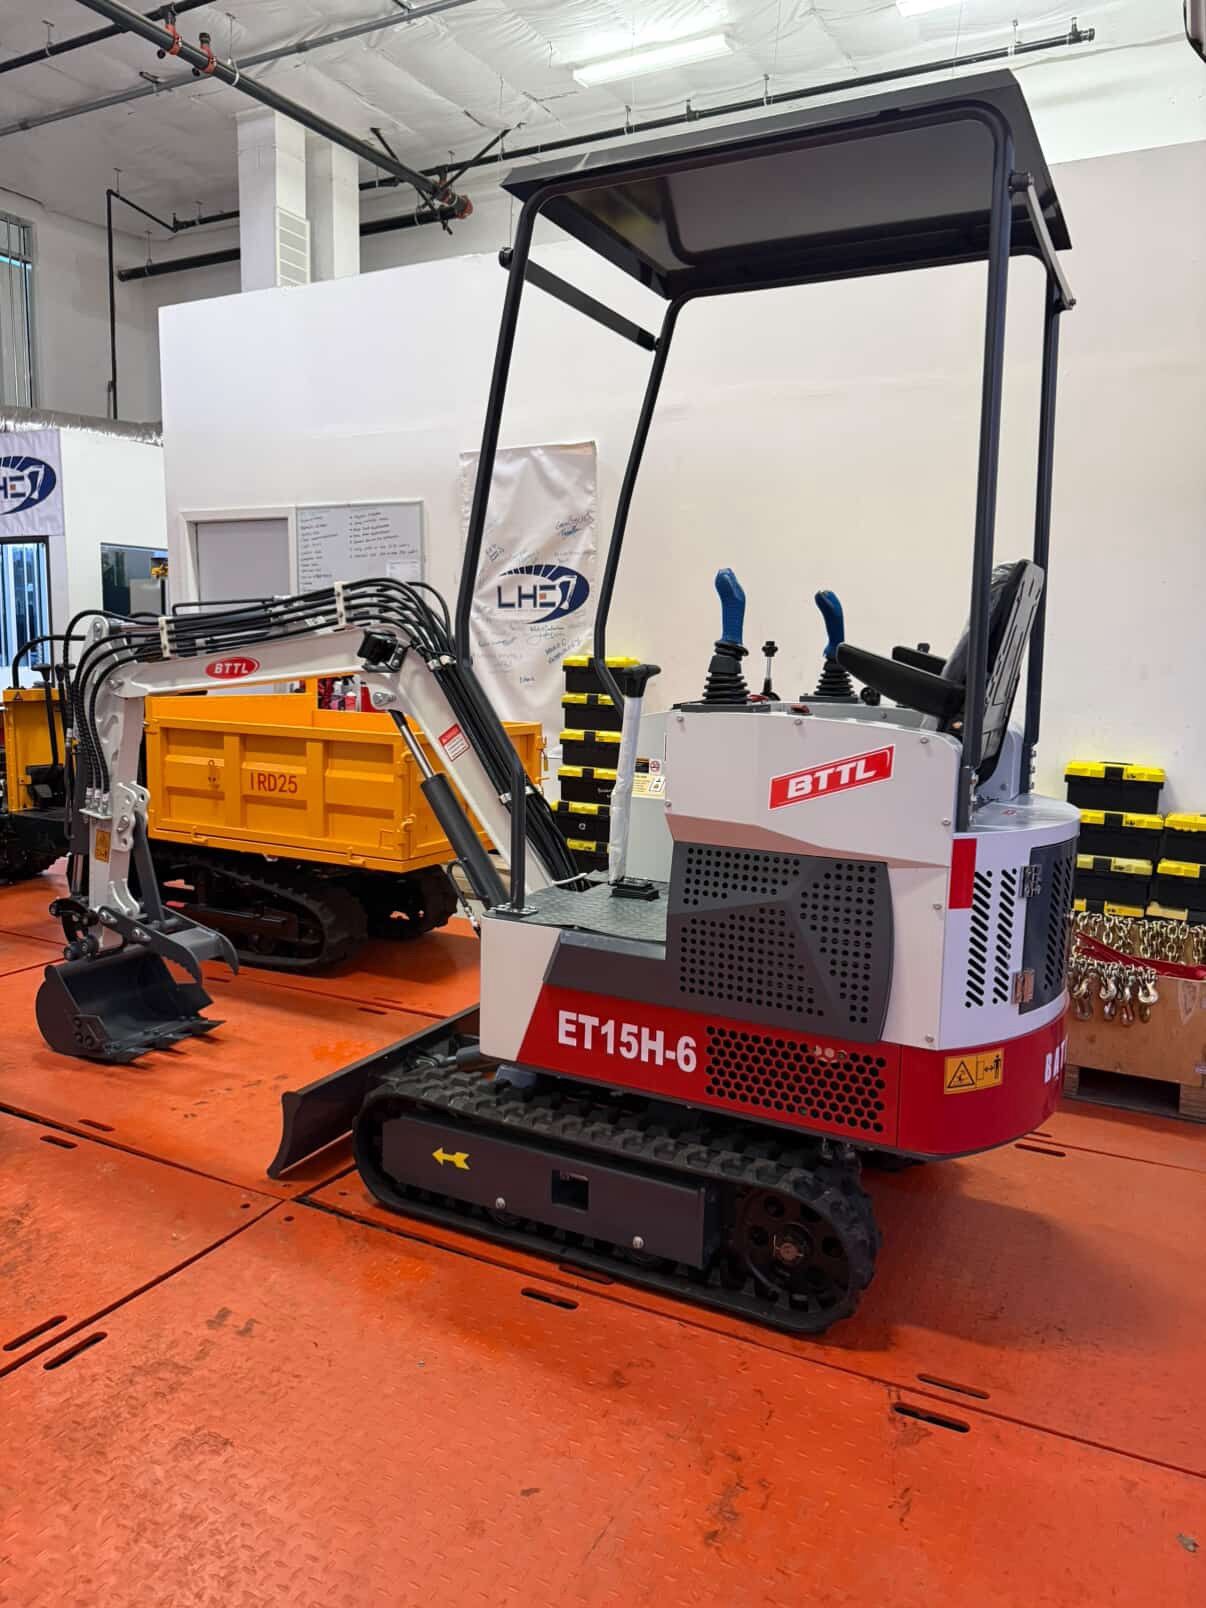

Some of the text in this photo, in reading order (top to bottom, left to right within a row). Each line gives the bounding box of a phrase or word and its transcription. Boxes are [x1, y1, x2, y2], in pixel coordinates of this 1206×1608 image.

[497, 584, 556, 609] LHE
[213, 662, 249, 674] BTTL
[787, 759, 878, 799] BTTL
[558, 1009, 697, 1073] ET15H-6
